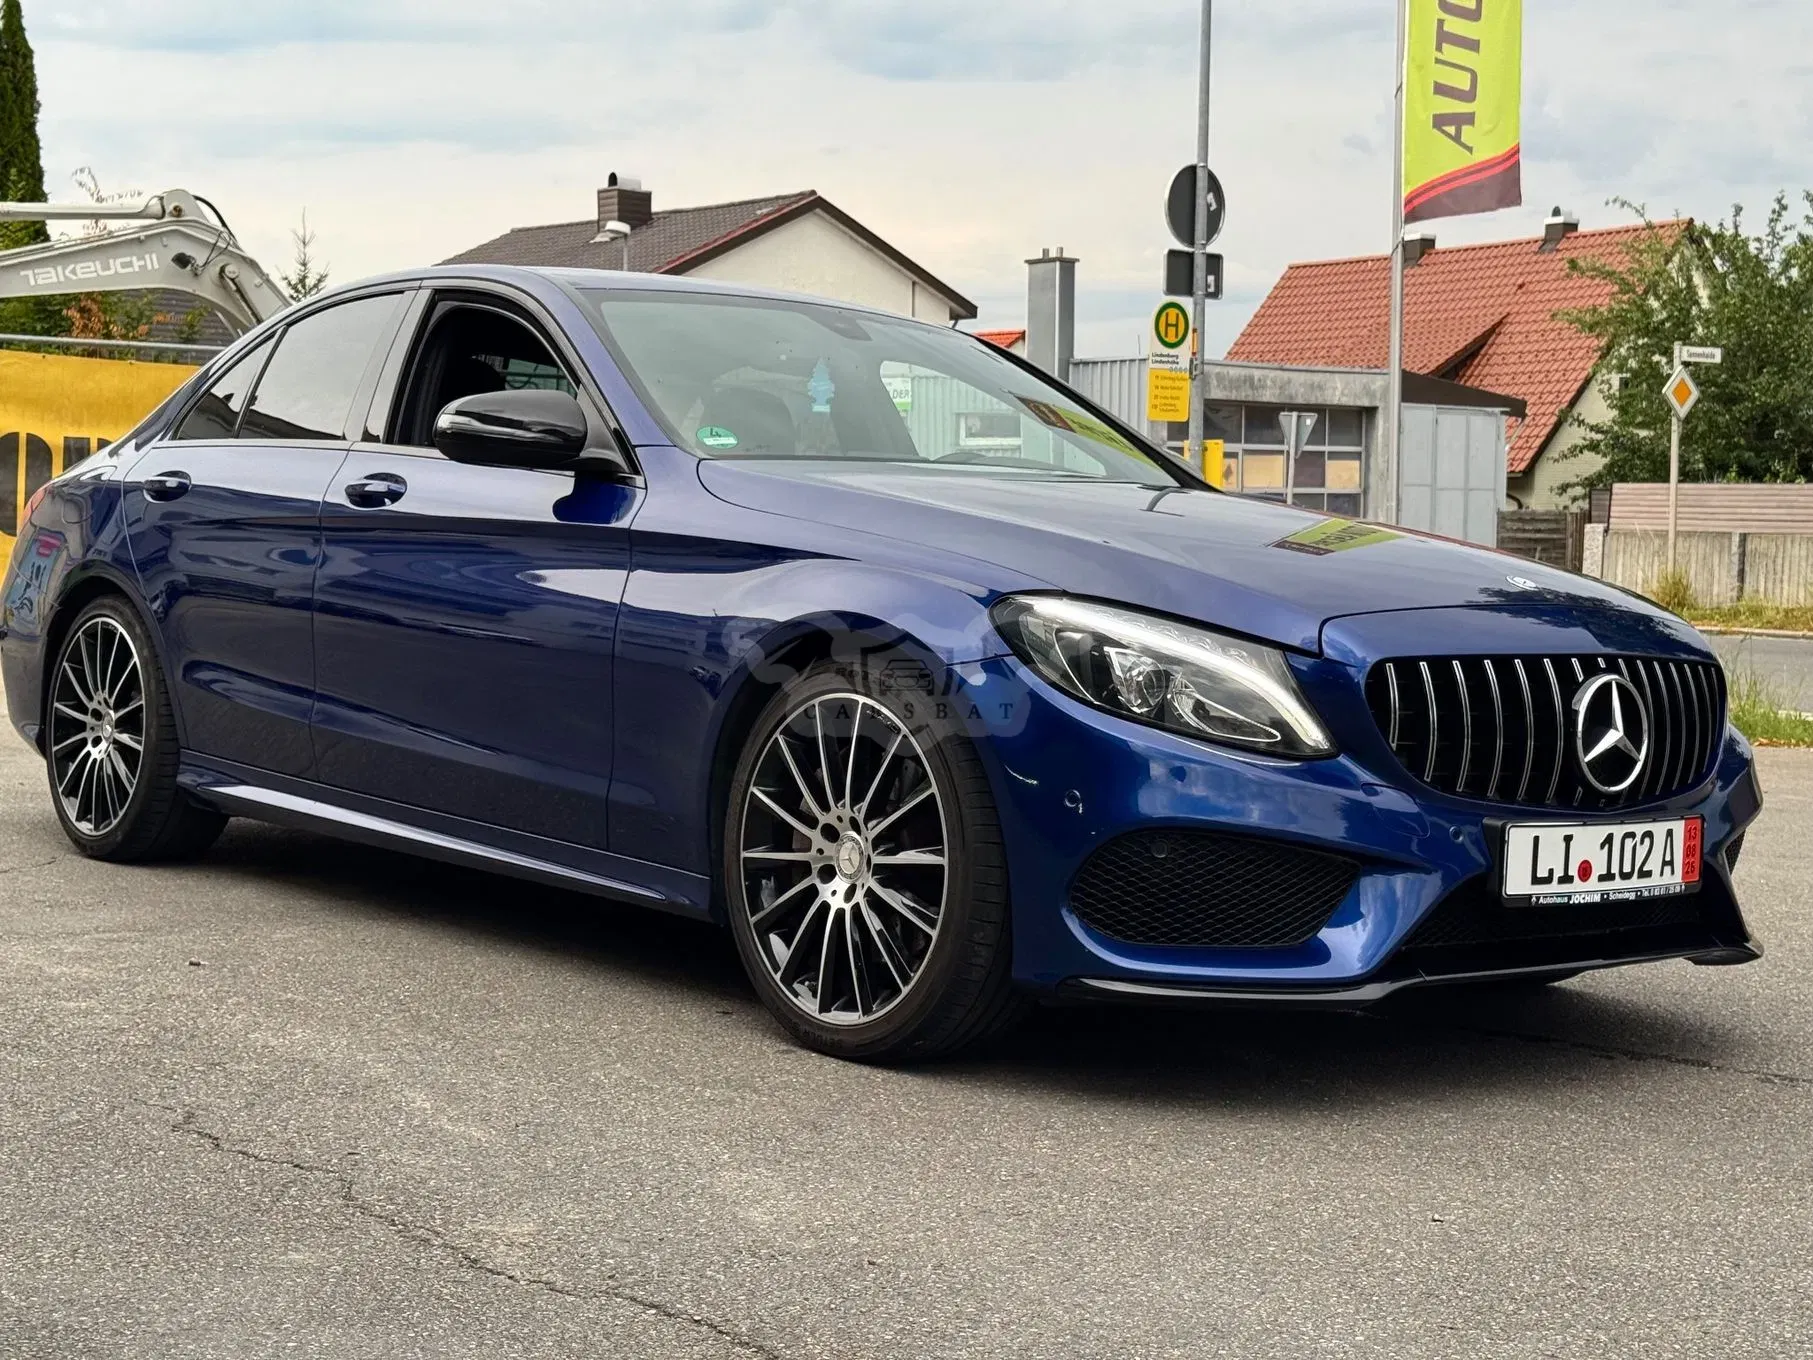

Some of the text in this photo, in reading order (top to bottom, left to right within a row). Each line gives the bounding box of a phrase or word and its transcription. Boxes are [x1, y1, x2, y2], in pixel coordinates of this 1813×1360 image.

[20, 253, 159, 287] TAKEUCHI
[1687, 825, 1697, 840] 13
[1531, 834, 1574, 885] LI
[1538, 896, 1568, 904] Autohaus
[1569, 893, 1601, 904] JOCHIM
